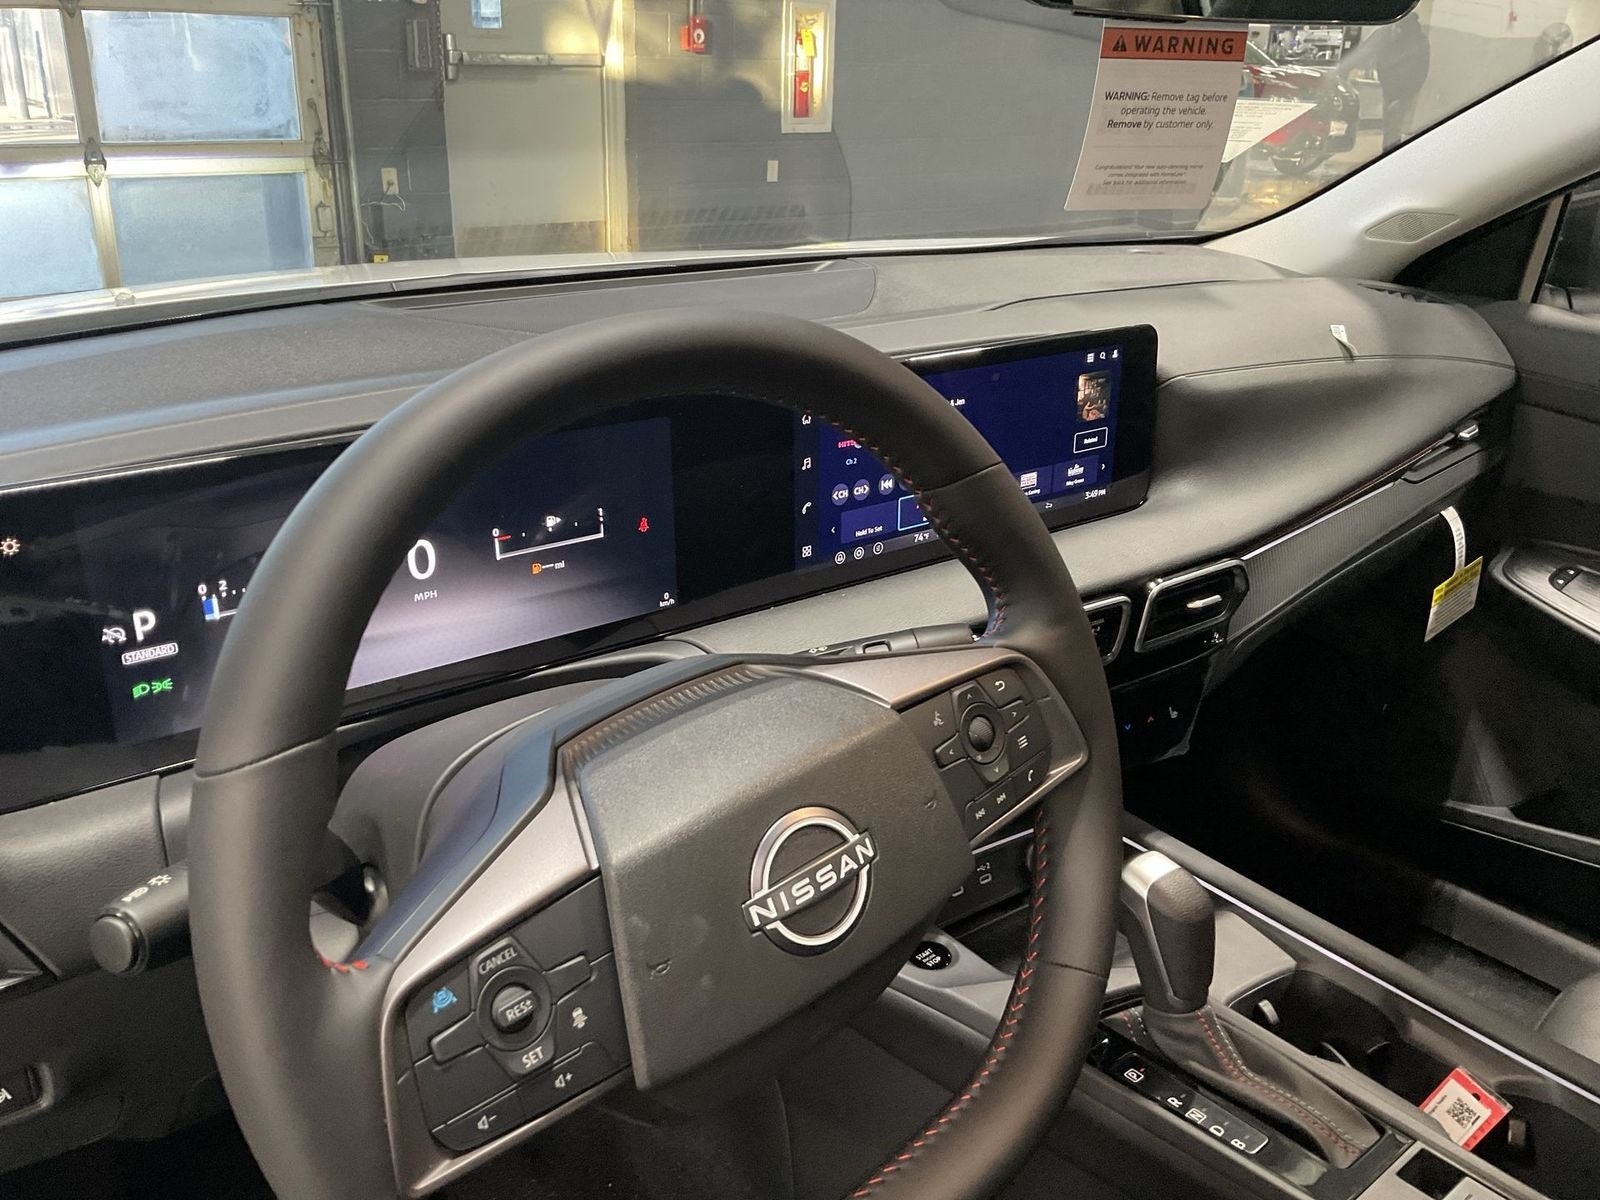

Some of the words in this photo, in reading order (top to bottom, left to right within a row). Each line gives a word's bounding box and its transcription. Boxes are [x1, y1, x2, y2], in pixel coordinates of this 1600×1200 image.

[1134, 35, 1234, 55] WARNING
[1104, 91, 1150, 101] WARNING:
[1151, 91, 1184, 102] Remove
[1186, 93, 1200, 104] tag
[1202, 92, 1228, 103] before
[1121, 106, 1160, 117] operating
[1162, 106, 1176, 115] the
[1178, 106, 1207, 116] vehicle.
[1107, 119, 1142, 129] Remove
[1143, 120, 1153, 131] by
[1155, 120, 1194, 129] customer
[1196, 120, 1214, 131] only.
[838, 489, 848, 498] CH
[853, 486, 864, 496] CH
[492, 527, 499, 537] 0
[855, 528, 867, 538] Hold
[867, 527, 874, 535] To
[874, 525, 883, 533] Set
[407, 539, 436, 580] 0
[554, 560, 565, 570] mi
[198, 583, 207, 595] 0
[218, 580, 228, 591] 2
[413, 589, 438, 602] MPH
[663, 592, 670, 600] 0
[132, 610, 156, 642] P
[124, 645, 175, 663] STANDARD
[748, 837, 875, 927] NISSAN
[915, 948, 933, 961] START
[478, 947, 518, 975] CANCEL
[926, 956, 941, 967] STOP
[521, 1046, 545, 1069] SET
[1129, 1072, 1138, 1080] P
[1166, 1096, 1183, 1108] R
[1189, 1111, 1203, 1121] N
[1209, 1125, 1224, 1137] D
[1230, 1138, 1246, 1150] B
